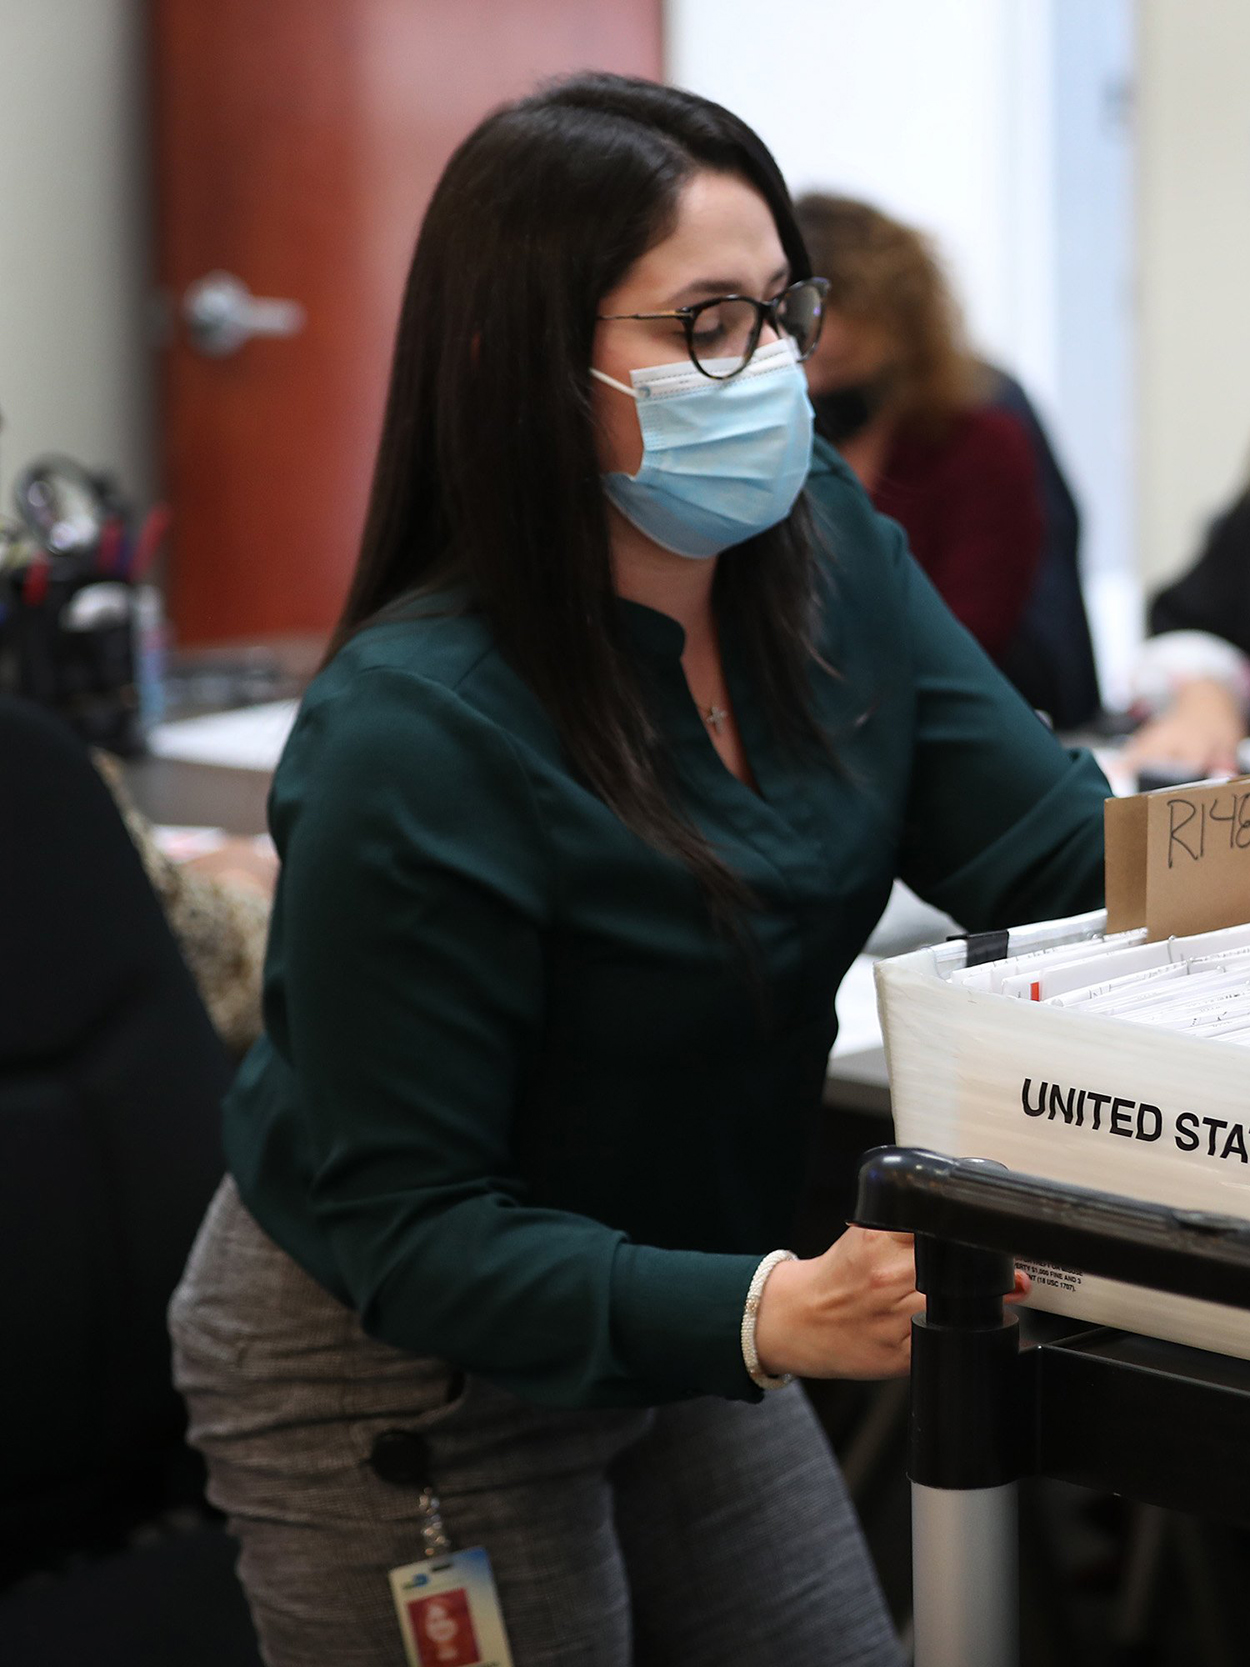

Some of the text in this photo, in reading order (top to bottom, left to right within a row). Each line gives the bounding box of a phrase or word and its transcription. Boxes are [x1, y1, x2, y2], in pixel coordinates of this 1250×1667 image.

[1021, 1078, 1163, 1142] UNITED
[1046, 1278, 1059, 1287] USC
[1050, 1271, 1063, 1280] FINE
[1064, 1275, 1077, 1283] AND
